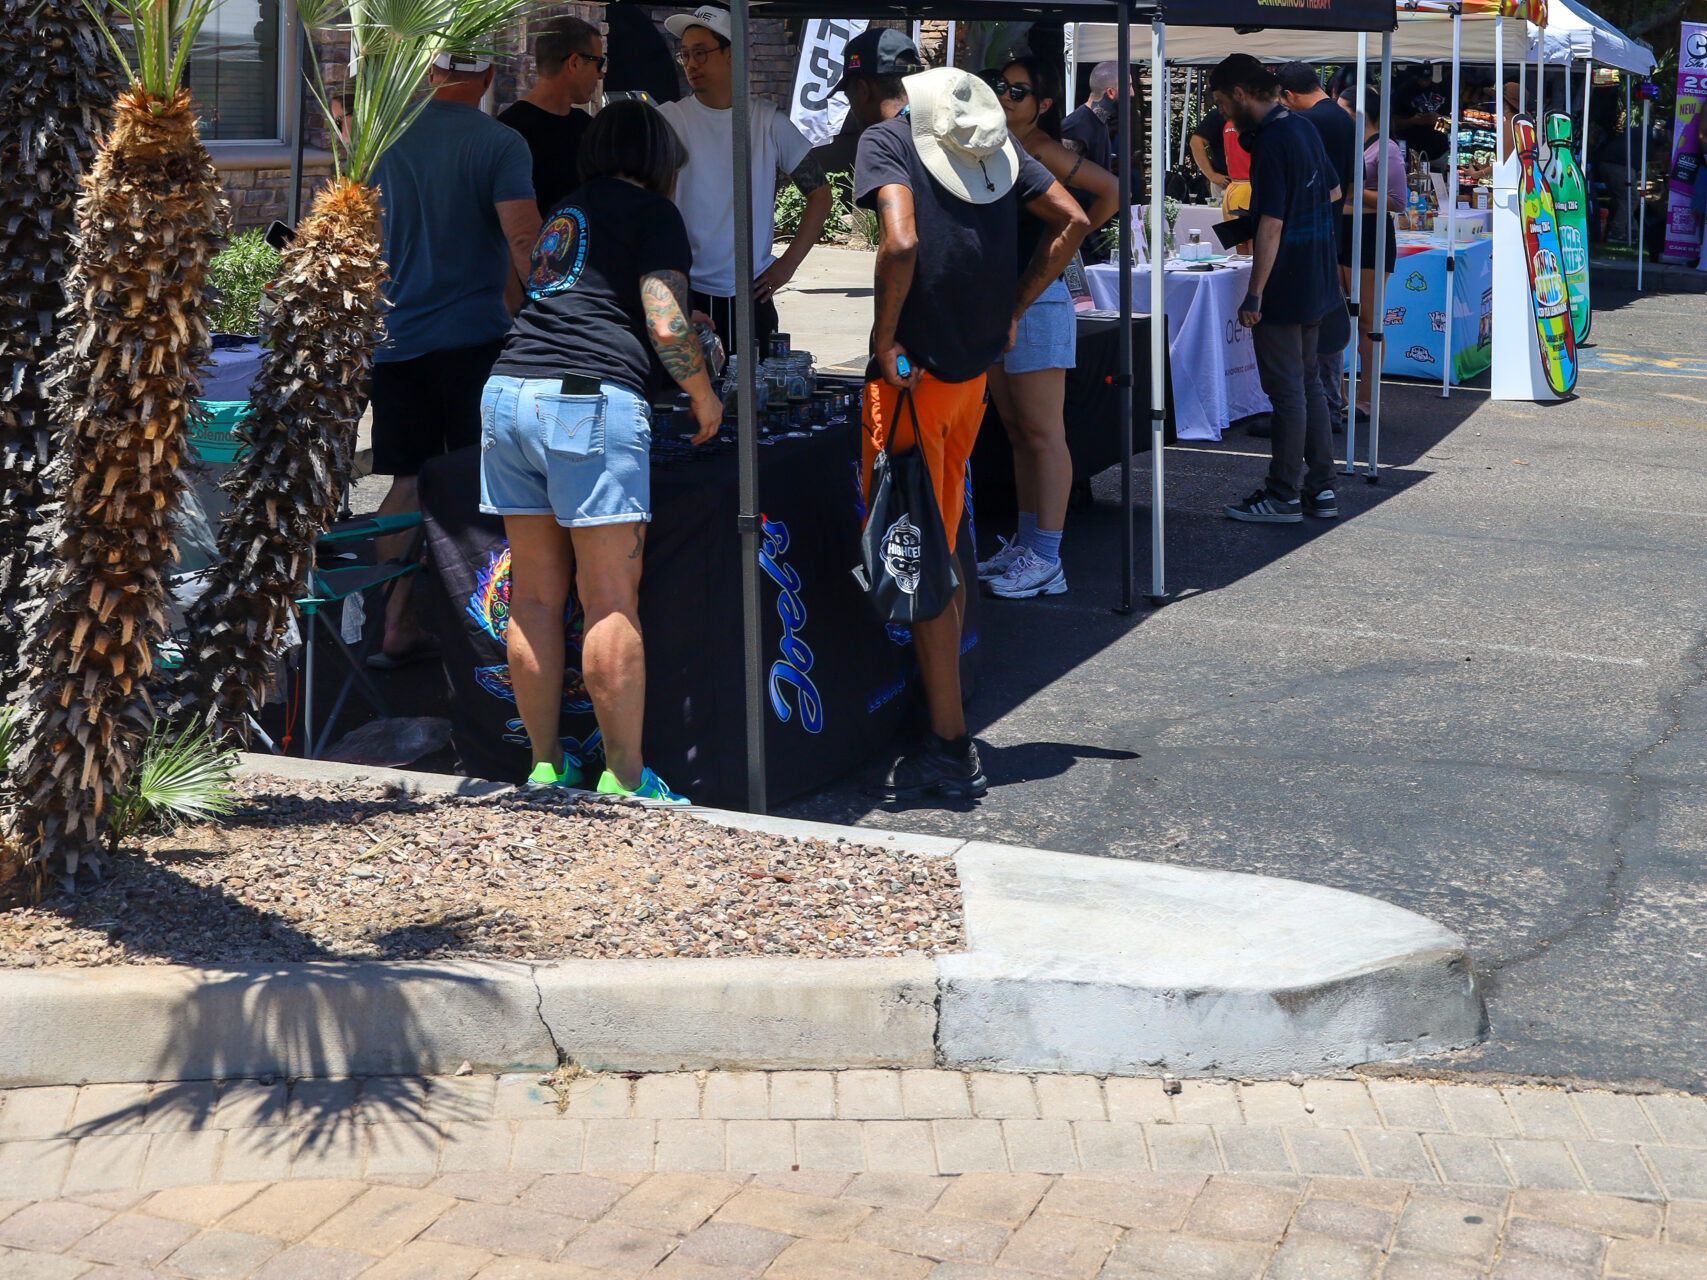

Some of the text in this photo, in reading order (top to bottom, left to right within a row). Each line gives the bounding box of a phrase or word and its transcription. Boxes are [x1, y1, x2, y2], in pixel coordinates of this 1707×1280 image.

[1679, 103, 1697, 116] NEW
[1560, 228, 1581, 250] NCLE
[1563, 247, 1585, 273] NIE'S
[758, 519, 823, 734] Joel's
